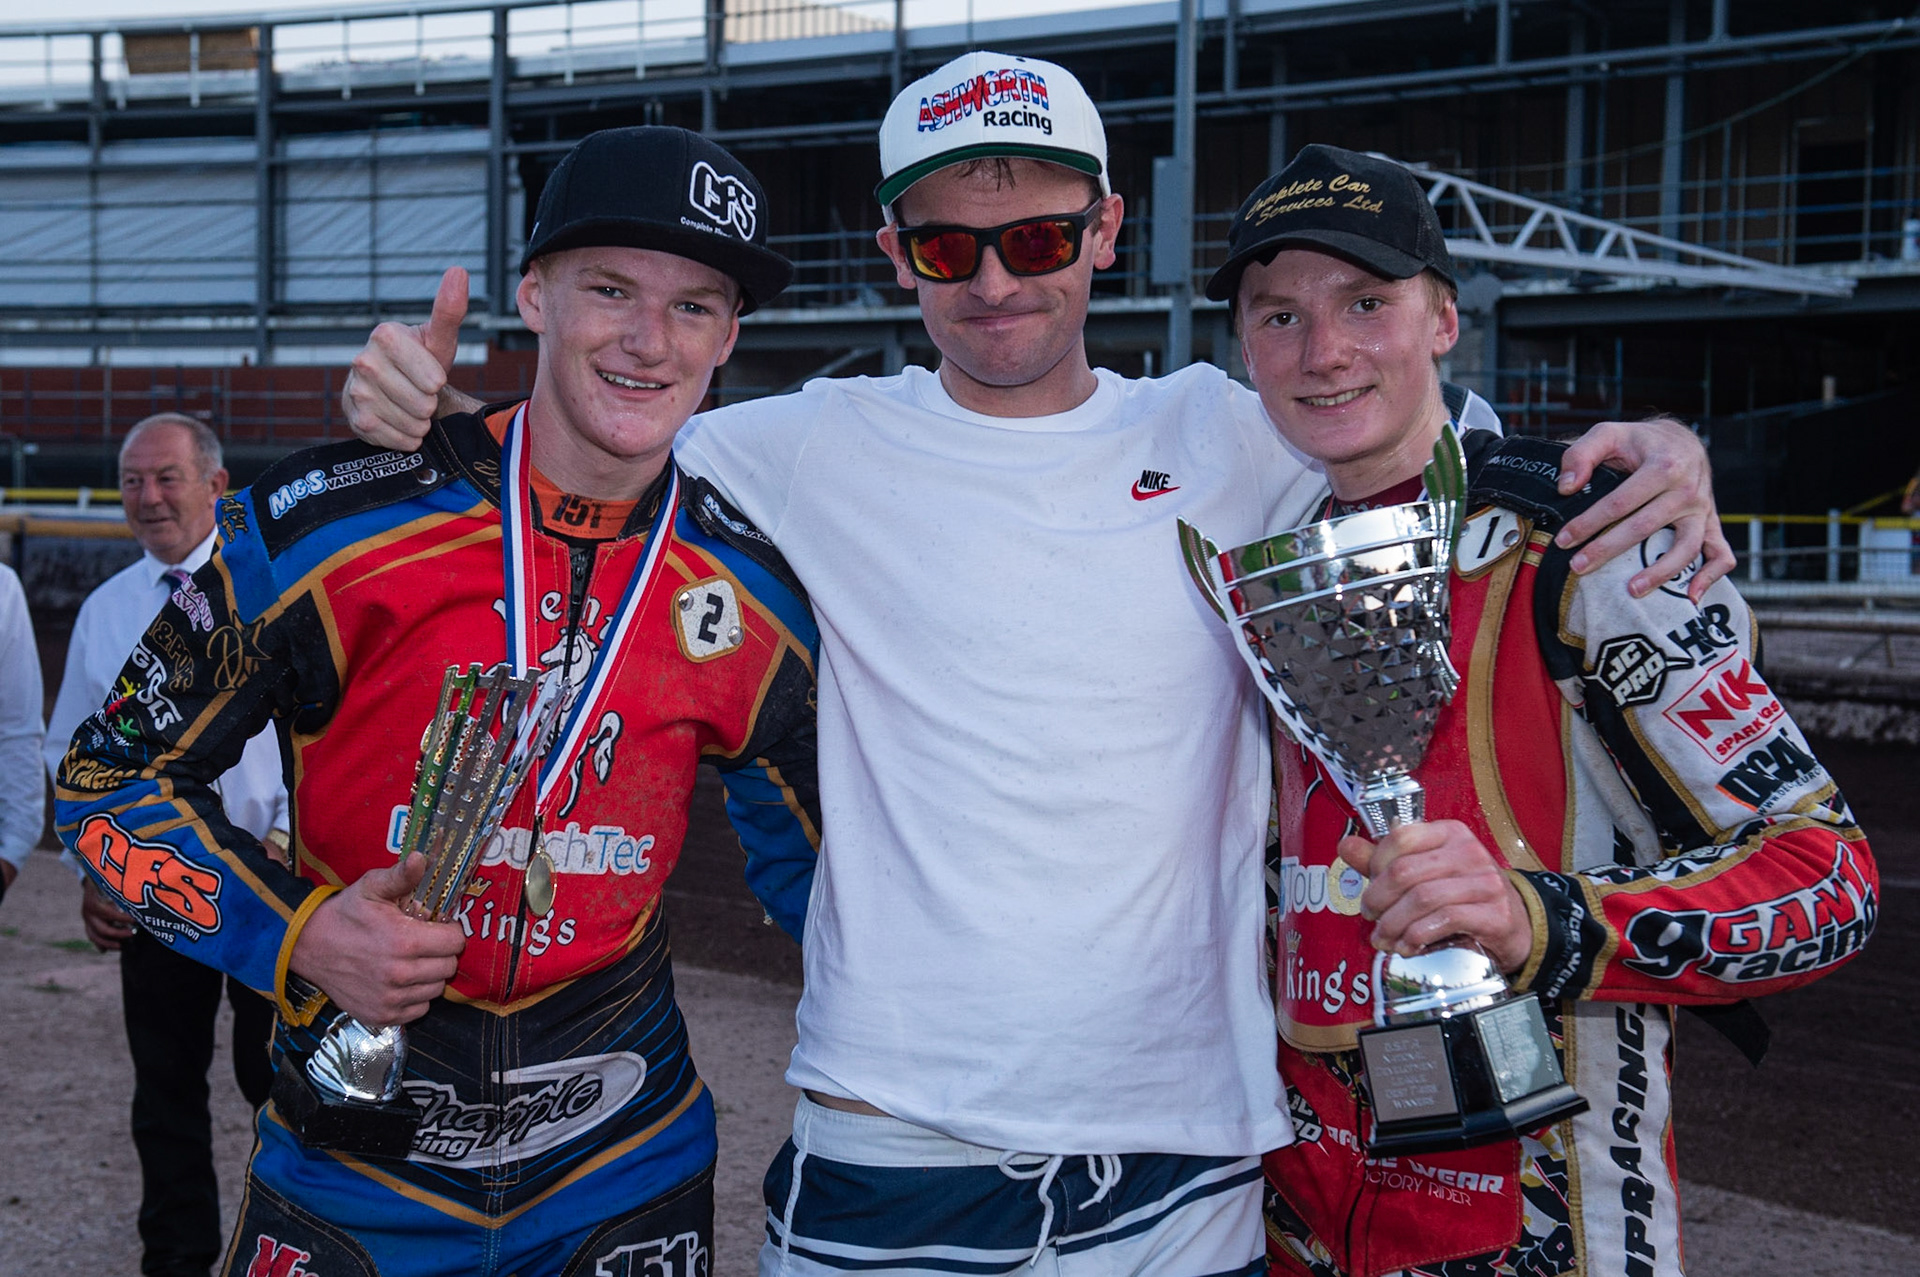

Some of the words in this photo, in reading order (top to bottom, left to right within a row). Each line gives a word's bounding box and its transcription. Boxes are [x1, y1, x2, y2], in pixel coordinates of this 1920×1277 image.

[917, 68, 1050, 132] ASHWORTH
[983, 106, 1053, 135] Racing
[1244, 178, 1324, 221] Complete
[1328, 173, 1371, 194] Car
[1255, 196, 1336, 226] Services
[1343, 195, 1384, 214] Ltd
[326, 472, 361, 490] VANS
[362, 469, 374, 482] &
[373, 453, 423, 478] TRUCKS
[333, 459, 364, 475] SELF
[1139, 469, 1171, 490] NIKE
[1500, 455, 1561, 482] KICKSTA
[268, 469, 326, 520] M&S
[1476, 515, 1501, 559] 1
[697, 592, 725, 645] 2
[1611, 651, 1667, 707] PRO
[1715, 717, 1766, 756] SPARK
[74, 814, 222, 932] CFS
[144, 915, 201, 941] Filtration
[452, 898, 578, 957] Kings
[1286, 956, 1371, 1014] Kings
[1408, 1158, 1508, 1197] WEAR
[1428, 1180, 1473, 1207] RIDER
